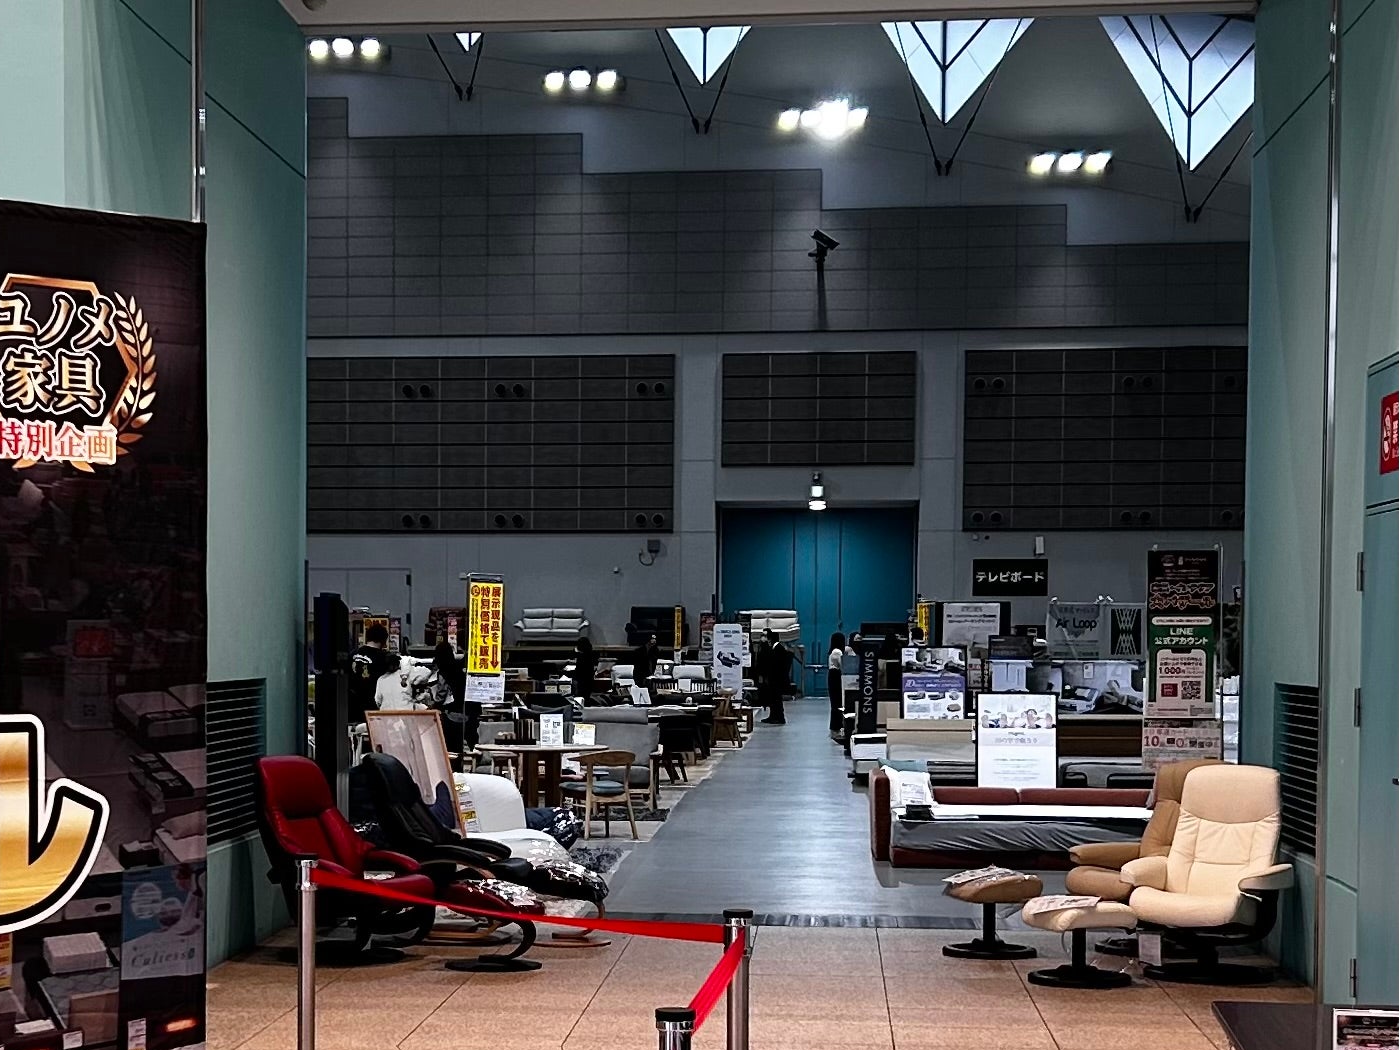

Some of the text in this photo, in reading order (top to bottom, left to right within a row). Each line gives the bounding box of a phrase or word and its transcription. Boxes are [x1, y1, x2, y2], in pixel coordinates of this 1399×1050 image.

[0, 345, 106, 417] 家具
[975, 571, 1045, 583] テレビボード
[1056, 617, 1098, 631] Air Loop
[1169, 627, 1194, 636] LINE
[1153, 636, 1209, 645] 公式アカウント
[863, 651, 875, 715] SIMMONS
